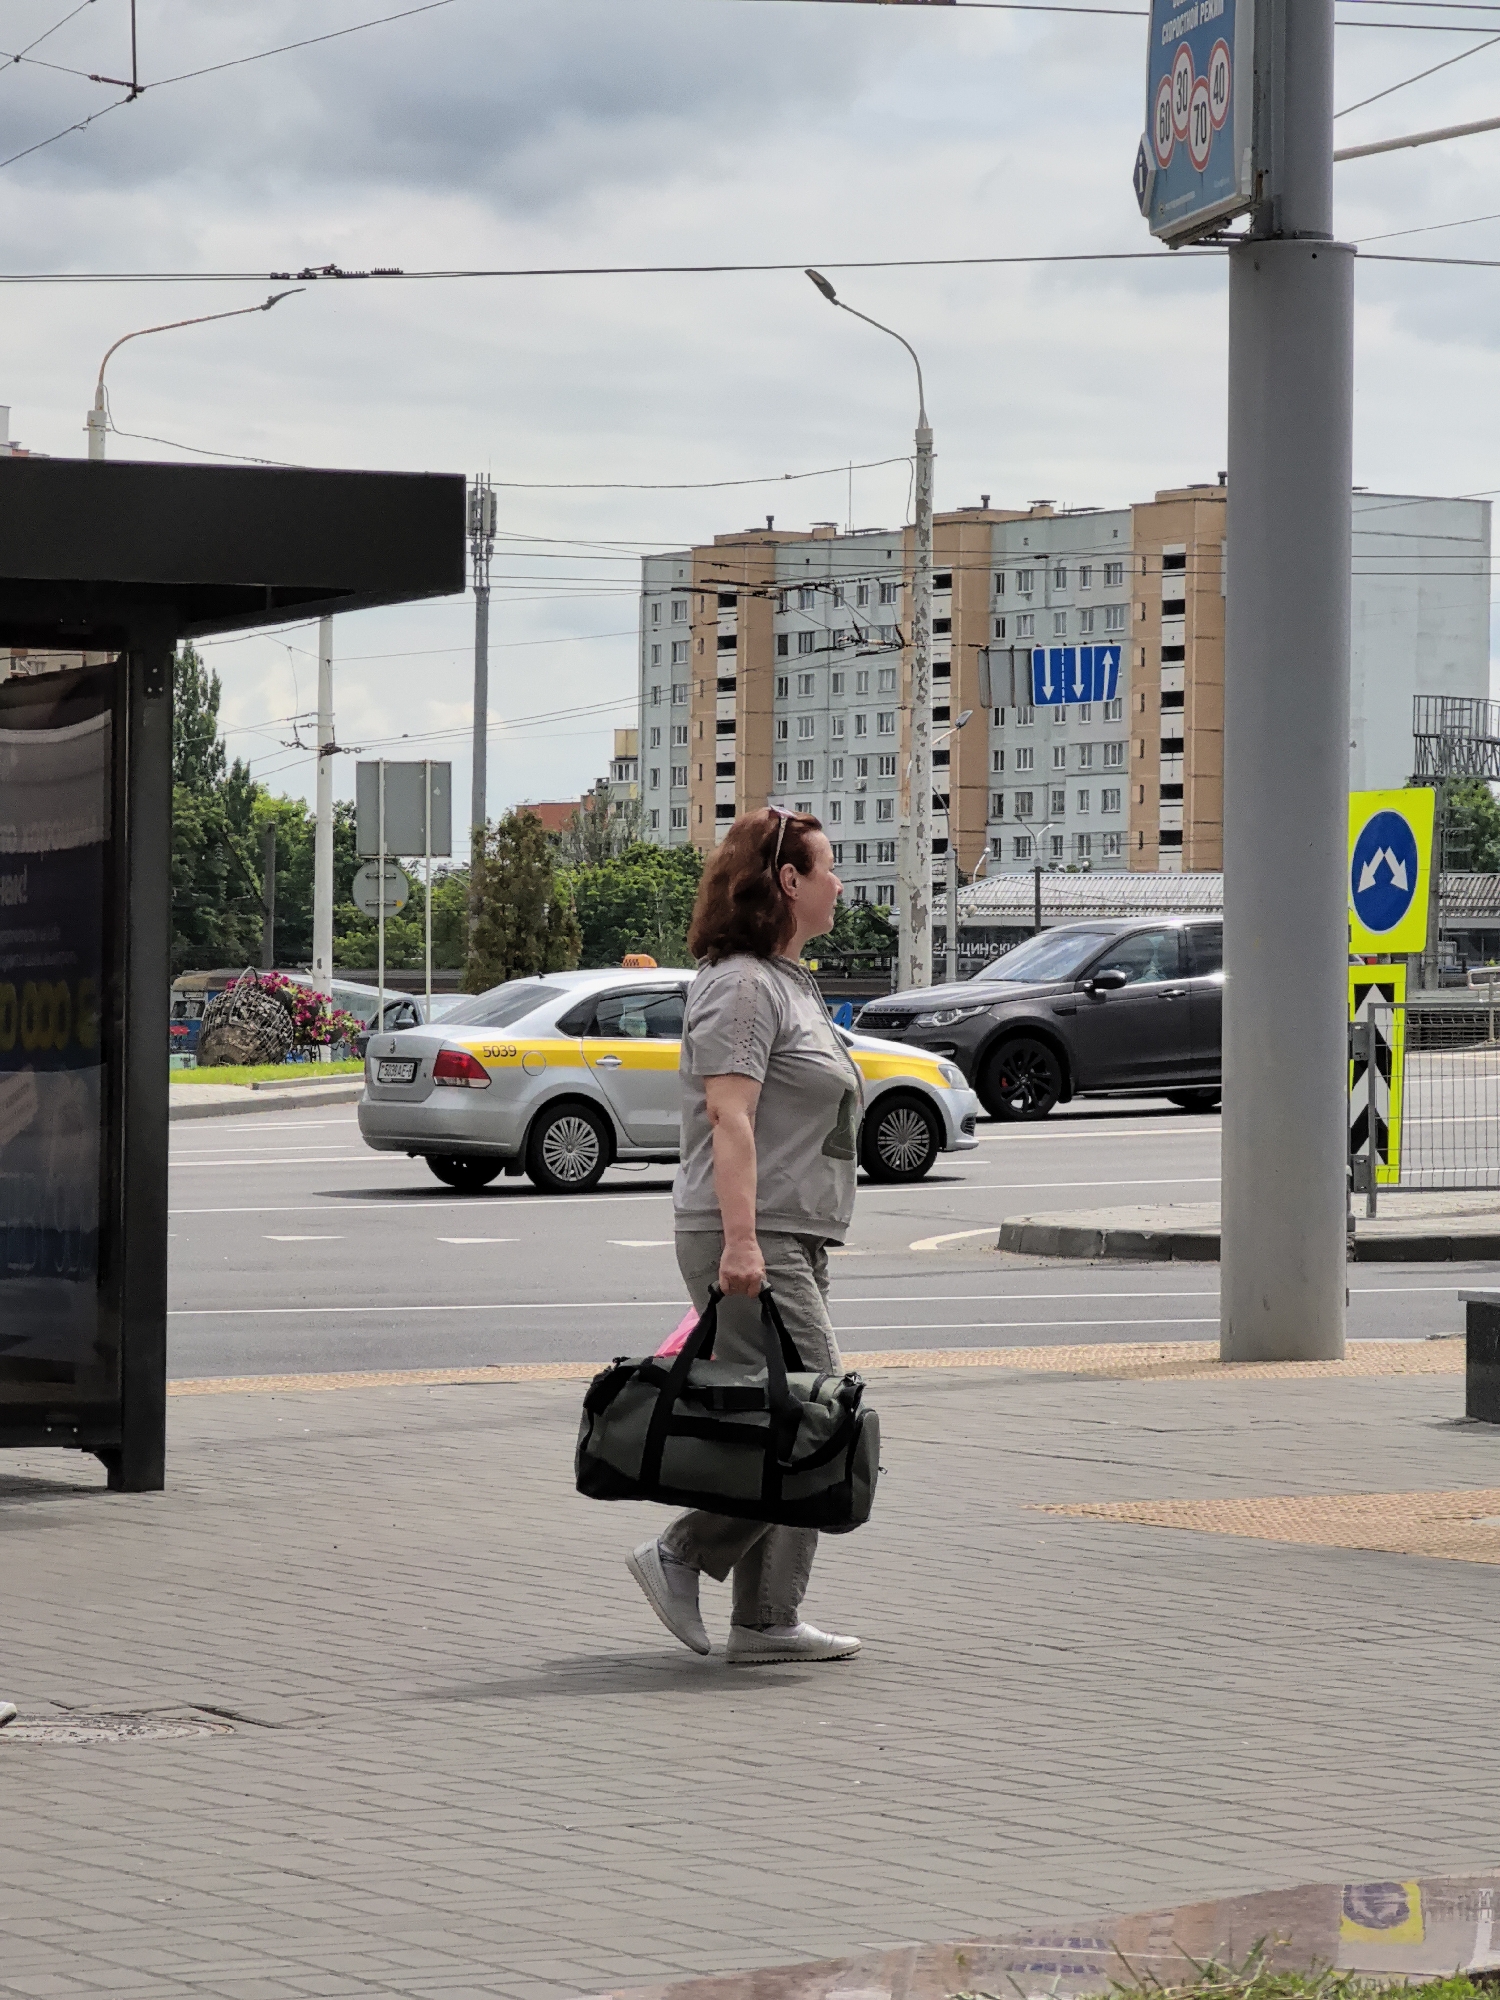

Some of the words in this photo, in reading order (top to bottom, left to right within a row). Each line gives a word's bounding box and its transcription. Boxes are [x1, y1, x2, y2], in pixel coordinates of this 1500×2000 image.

[1162, 1, 1199, 46] СКОРОСТНОЙ
[1176, 68, 1188, 115] 30
[1213, 62, 1225, 104] 40
[1159, 99, 1170, 145] 60
[1193, 101, 1207, 147] 70
[483, 1045, 517, 1058] 5039
